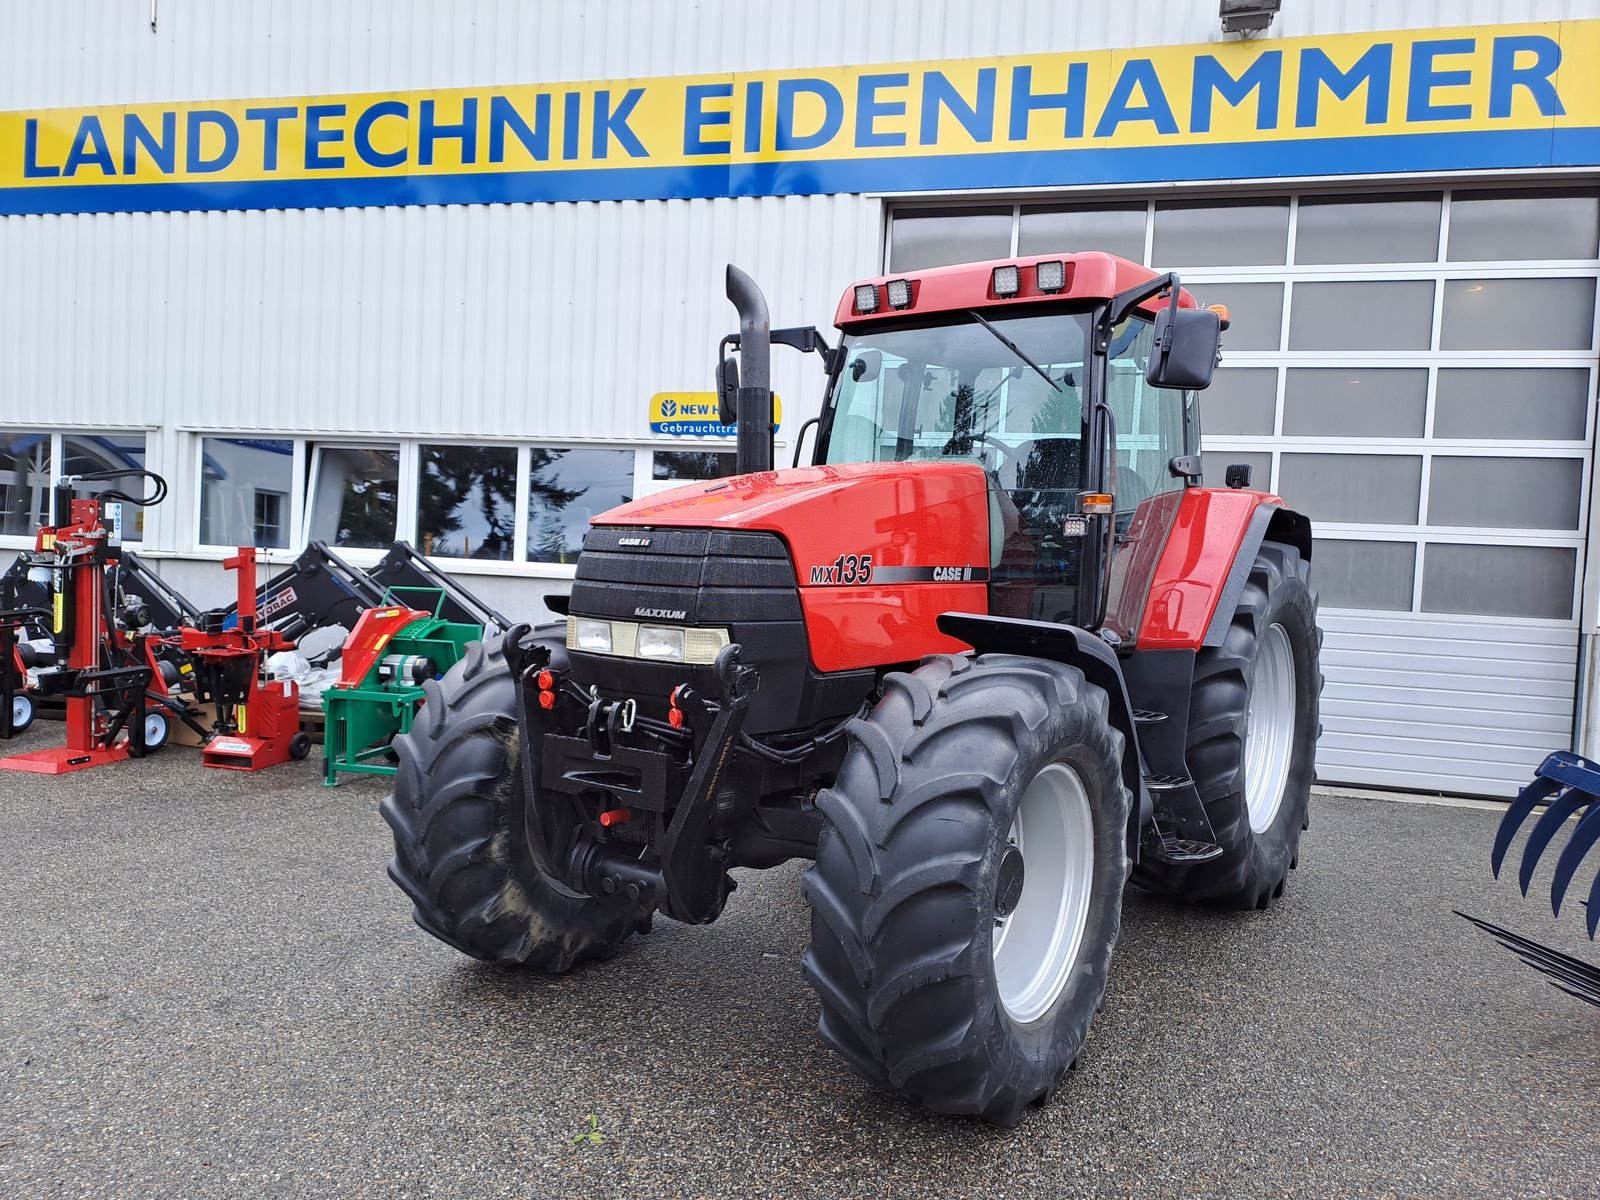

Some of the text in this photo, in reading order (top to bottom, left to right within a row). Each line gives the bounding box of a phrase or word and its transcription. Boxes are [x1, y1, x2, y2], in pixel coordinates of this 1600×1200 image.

[23, 35, 1566, 178] LANDTECHNIK EIDENHAMMER
[680, 404, 708, 415] NEW
[660, 422, 737, 433] Gebrauchttra
[810, 554, 873, 585] MX135
[933, 566, 962, 581] CASE
[256, 594, 294, 620] YDRAC
[634, 607, 686, 619] MAXXUM
